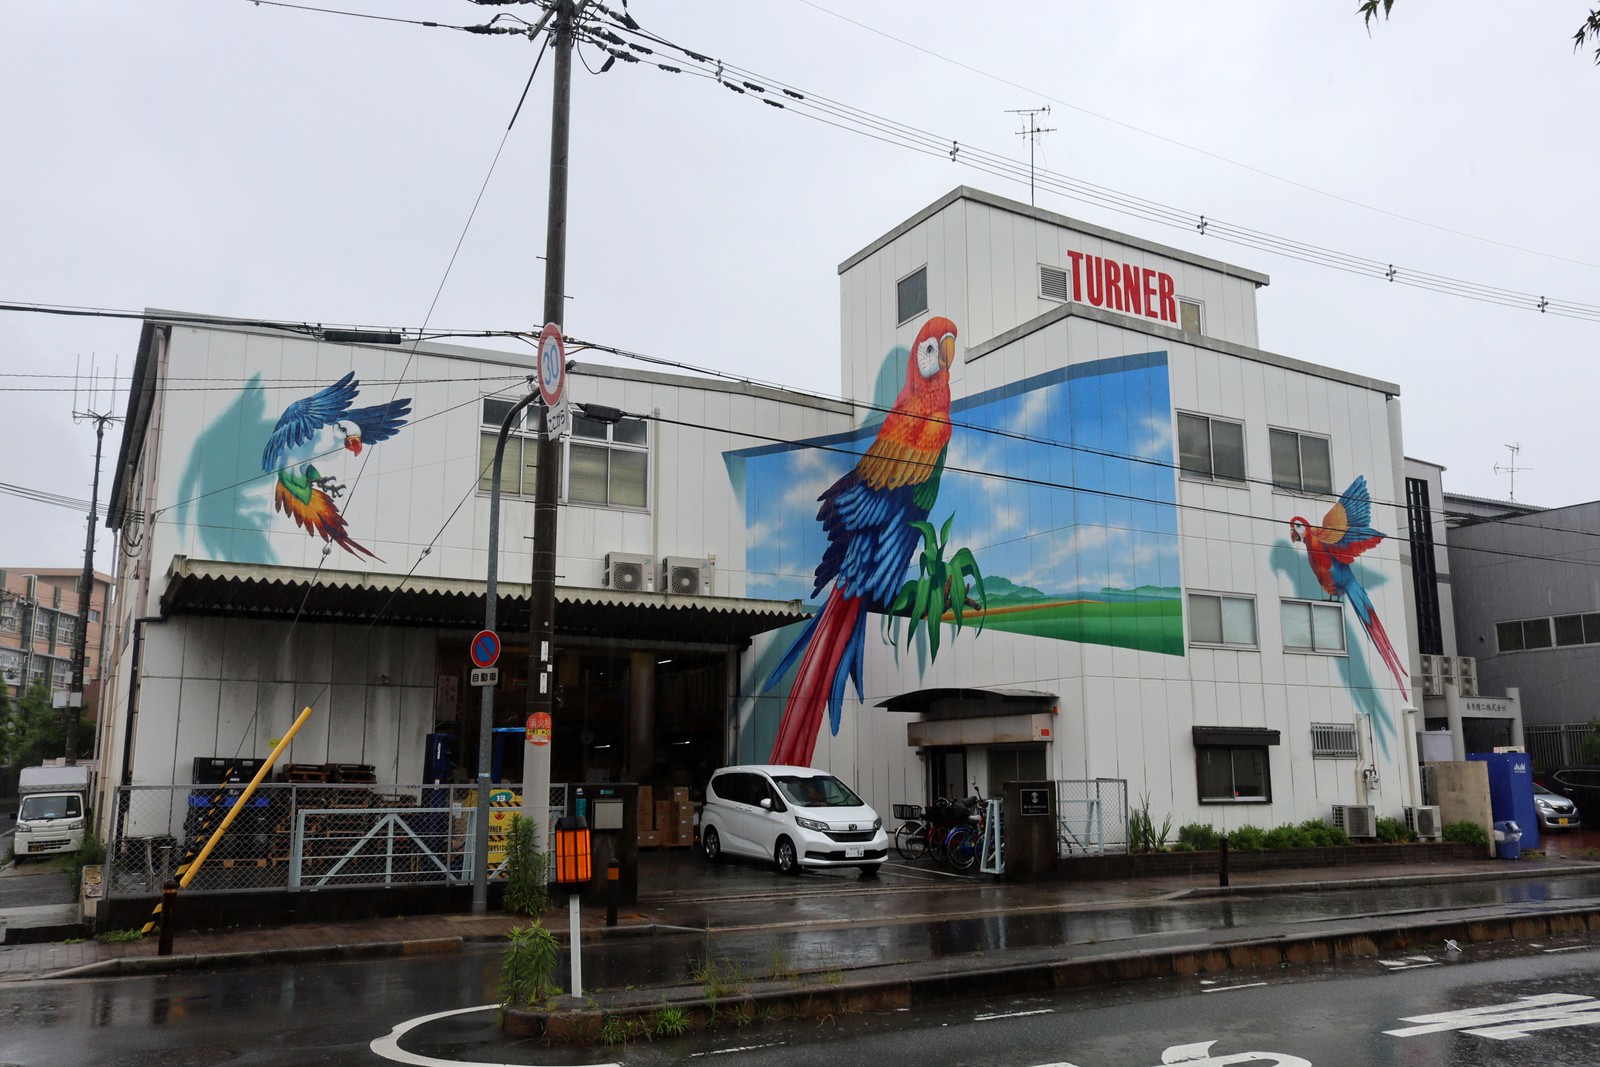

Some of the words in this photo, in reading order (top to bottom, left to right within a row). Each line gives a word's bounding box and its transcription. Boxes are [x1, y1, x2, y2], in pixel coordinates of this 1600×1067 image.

[1067, 250, 1177, 323] TURNER
[543, 345, 559, 385] 30
[472, 672, 496, 682] 自動車
